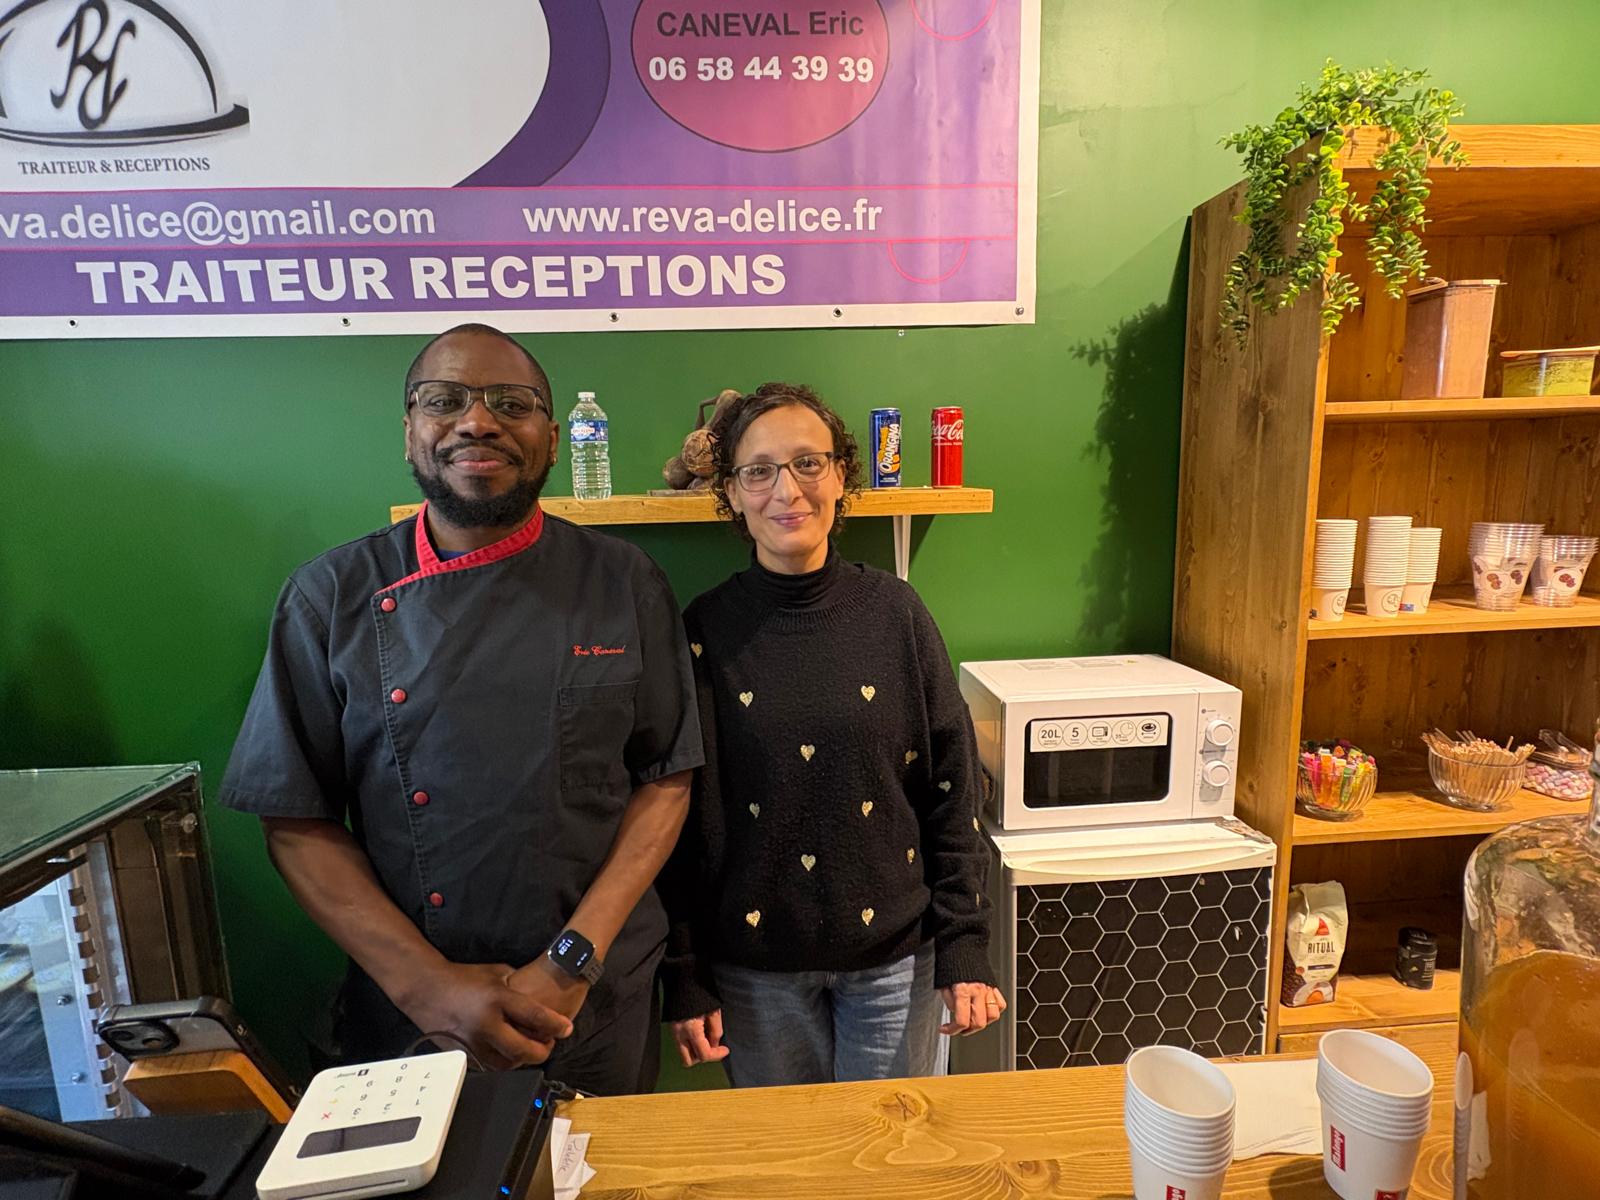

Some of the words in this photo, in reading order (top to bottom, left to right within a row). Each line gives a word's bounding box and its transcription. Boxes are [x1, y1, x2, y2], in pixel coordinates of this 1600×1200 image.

[656, 11, 800, 37] CANEVAL
[809, 10, 864, 36] Eric
[649, 56, 687, 81] 06
[697, 56, 734, 81] 58
[744, 56, 782, 80] 44
[791, 56, 828, 81] 39
[838, 57, 874, 82] 39
[18, 159, 98, 175] TRAITEUR
[100, 160, 112, 173] &
[114, 157, 211, 174] RECEPTIONS
[0, 200, 436, 245] va.delice@gmail.com
[522, 198, 883, 234] www.reva-delice.fr
[76, 259, 394, 304] TRAITEUR
[409, 254, 786, 299] RECEPTIONS
[1041, 729, 1061, 739] 20L
[1071, 727, 1080, 738] 5
[1307, 941, 1335, 954] RITUAL
